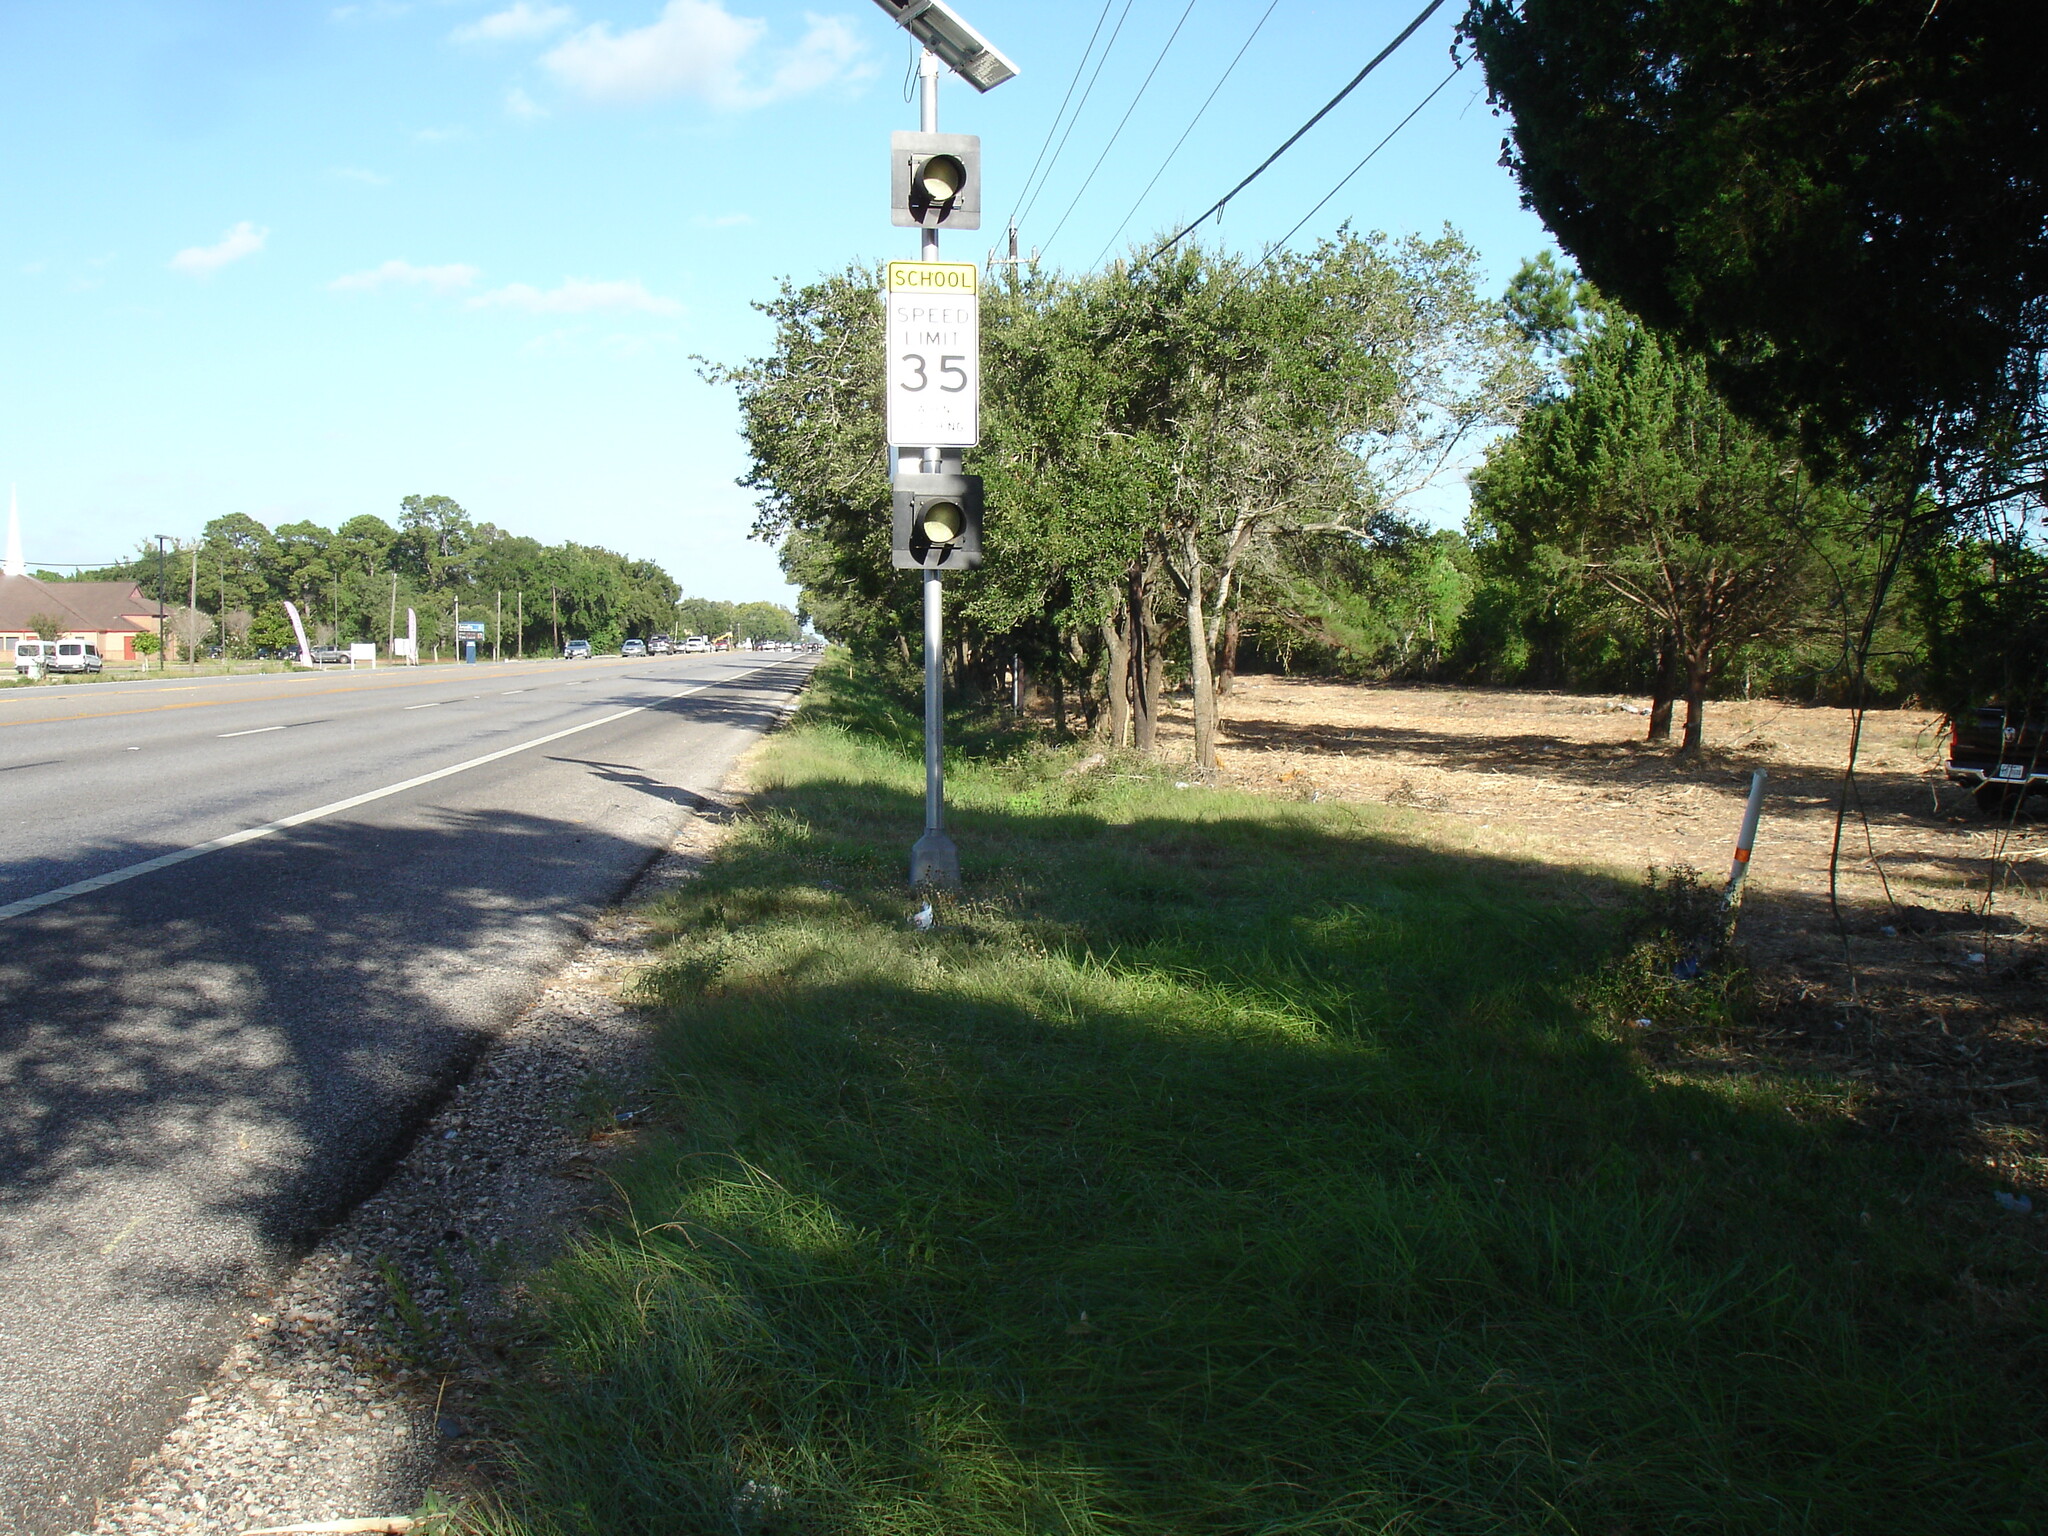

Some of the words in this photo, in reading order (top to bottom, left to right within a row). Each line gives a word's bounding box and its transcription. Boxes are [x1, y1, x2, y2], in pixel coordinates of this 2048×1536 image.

[895, 270, 972, 288] SCHOOL
[897, 307, 969, 324] SPEED
[900, 353, 968, 393] 35
